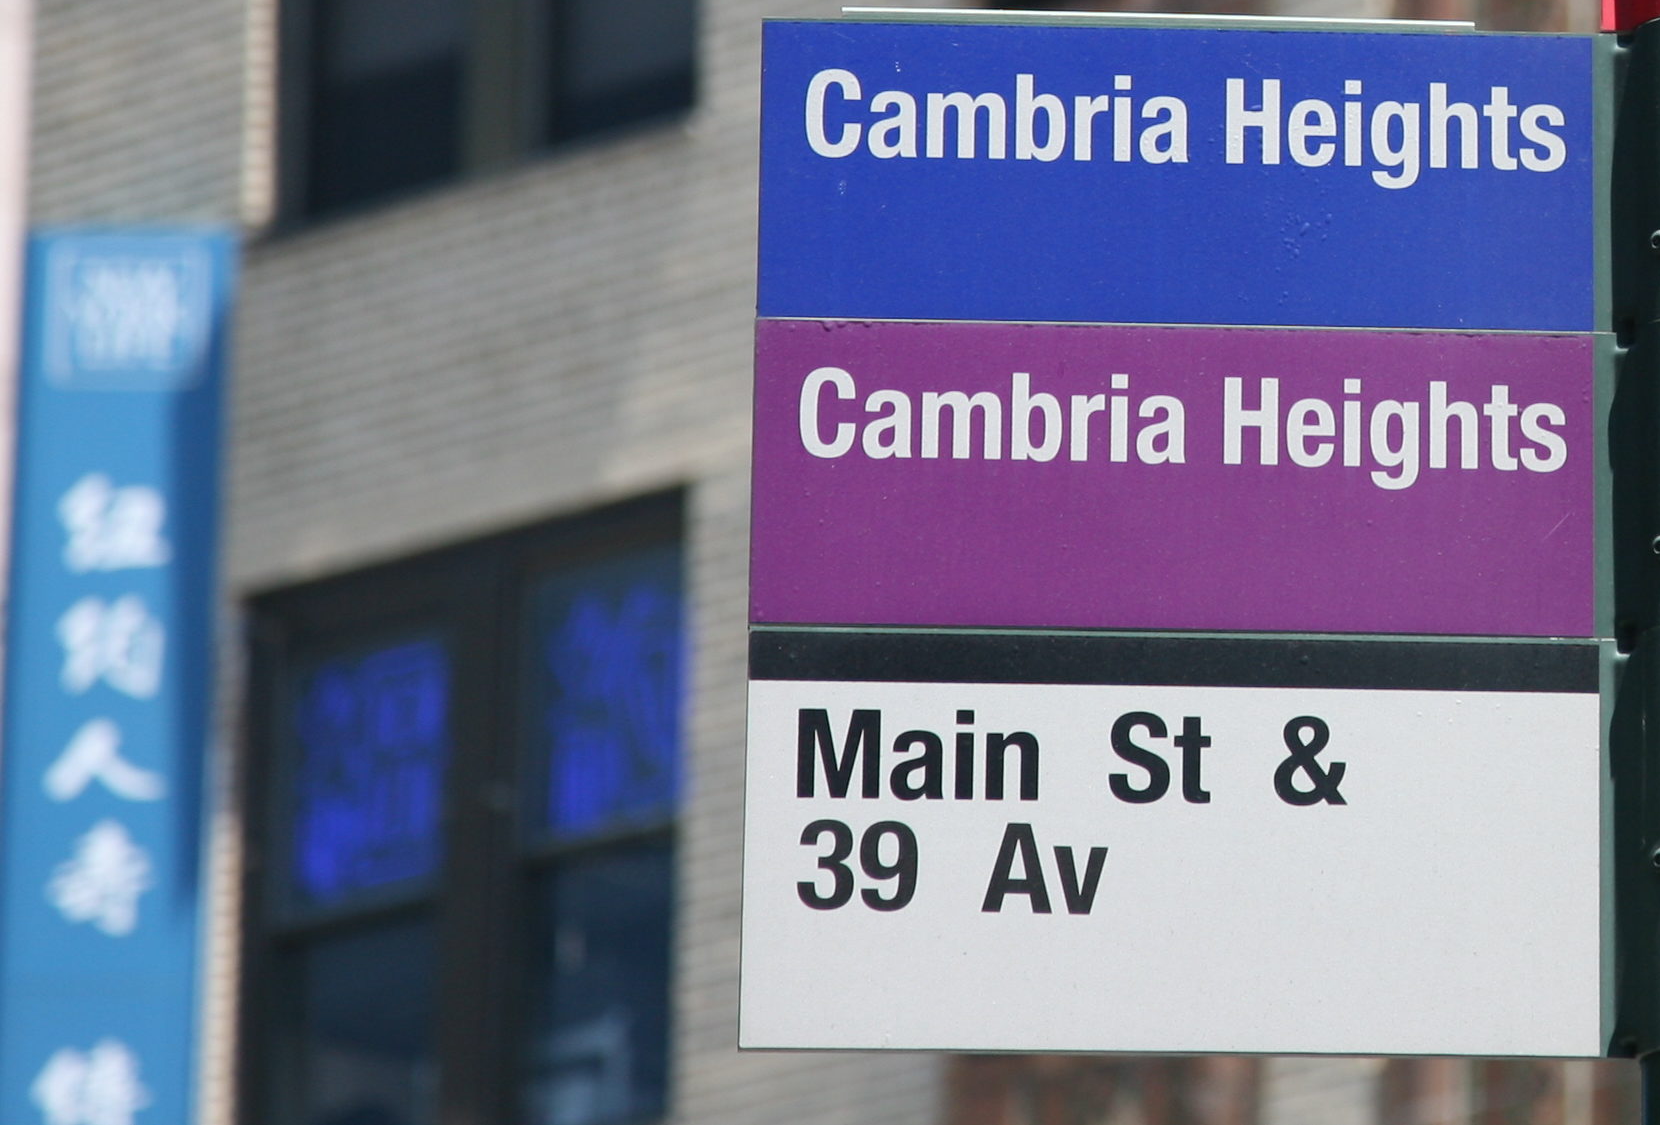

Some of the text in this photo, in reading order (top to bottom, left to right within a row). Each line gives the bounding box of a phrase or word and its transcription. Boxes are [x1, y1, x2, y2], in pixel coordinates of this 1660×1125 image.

[806, 69, 1566, 189] Cambria Heights
[800, 367, 1567, 490] Cambria Heights
[798, 709, 1346, 805] Main St &
[798, 820, 1107, 913] 39 Av
